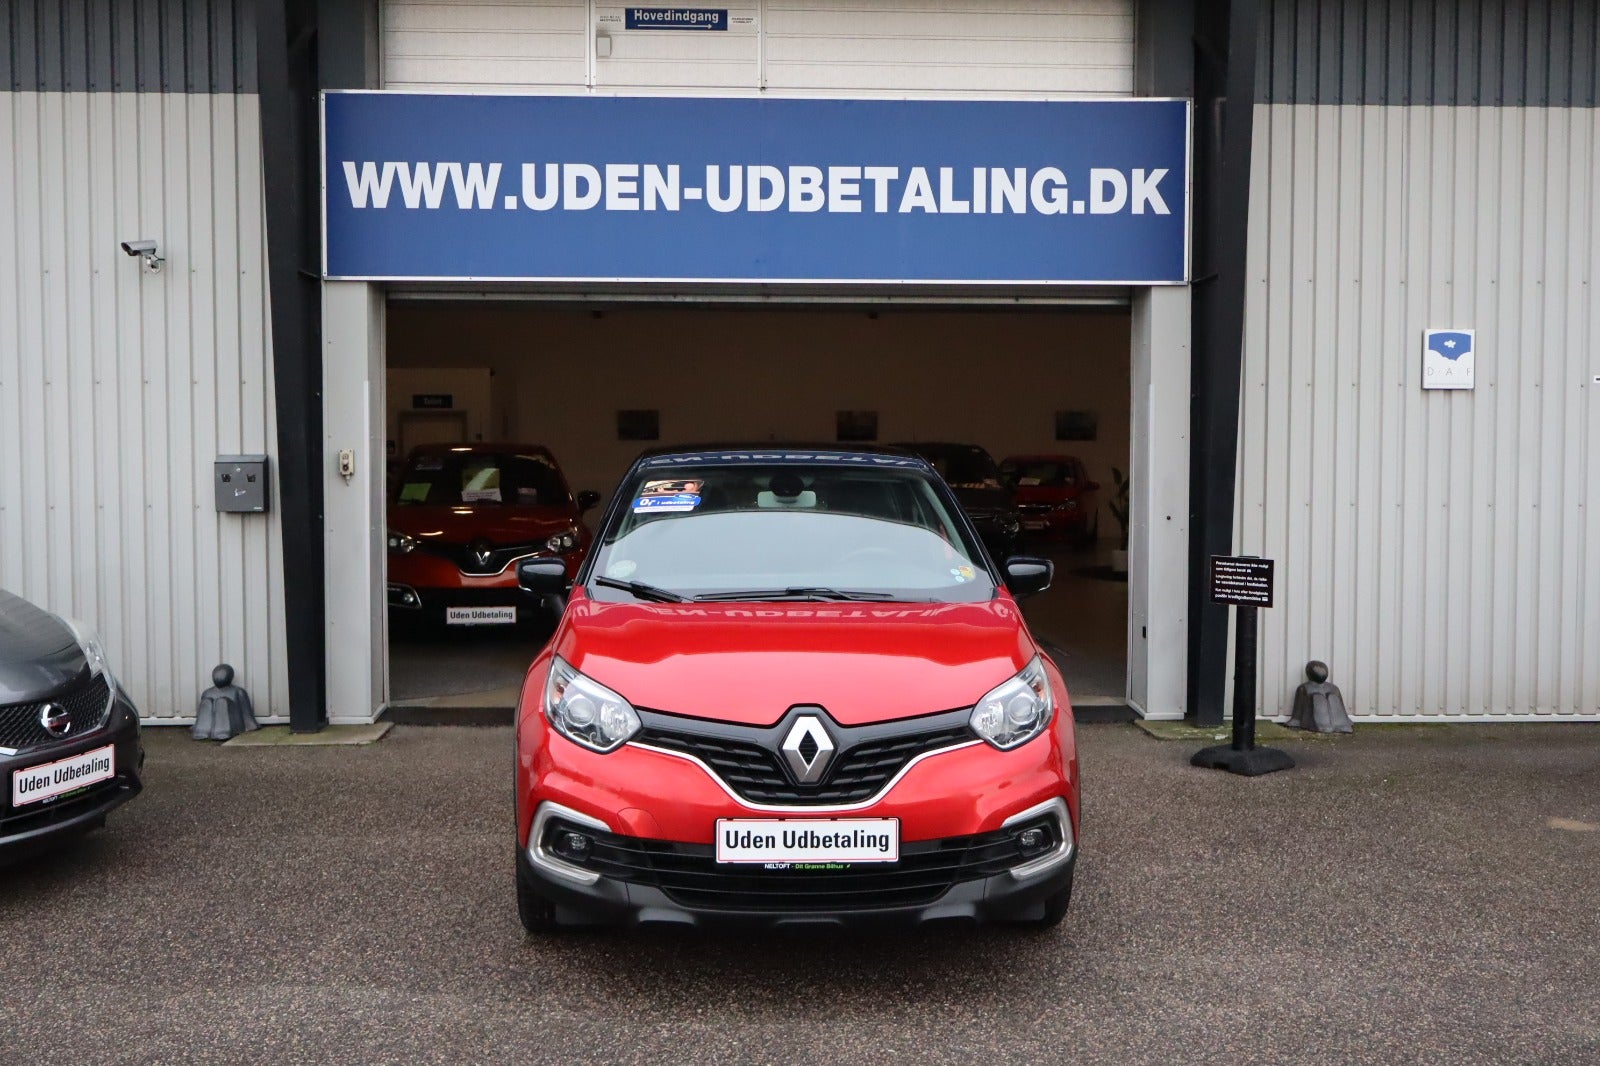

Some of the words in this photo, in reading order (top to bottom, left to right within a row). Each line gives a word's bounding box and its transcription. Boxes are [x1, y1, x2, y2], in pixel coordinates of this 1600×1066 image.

[634, 10, 719, 23] Hovedindgang
[342, 161, 1171, 216] WWW.UDEN-UDBETALING.DK
[450, 611, 469, 619] Uden
[472, 610, 513, 620] Udbetaling
[19, 776, 50, 793] Uden
[54, 757, 110, 784] Udbetaling
[726, 830, 776, 849] Uden
[782, 829, 890, 852] Udbetaling
